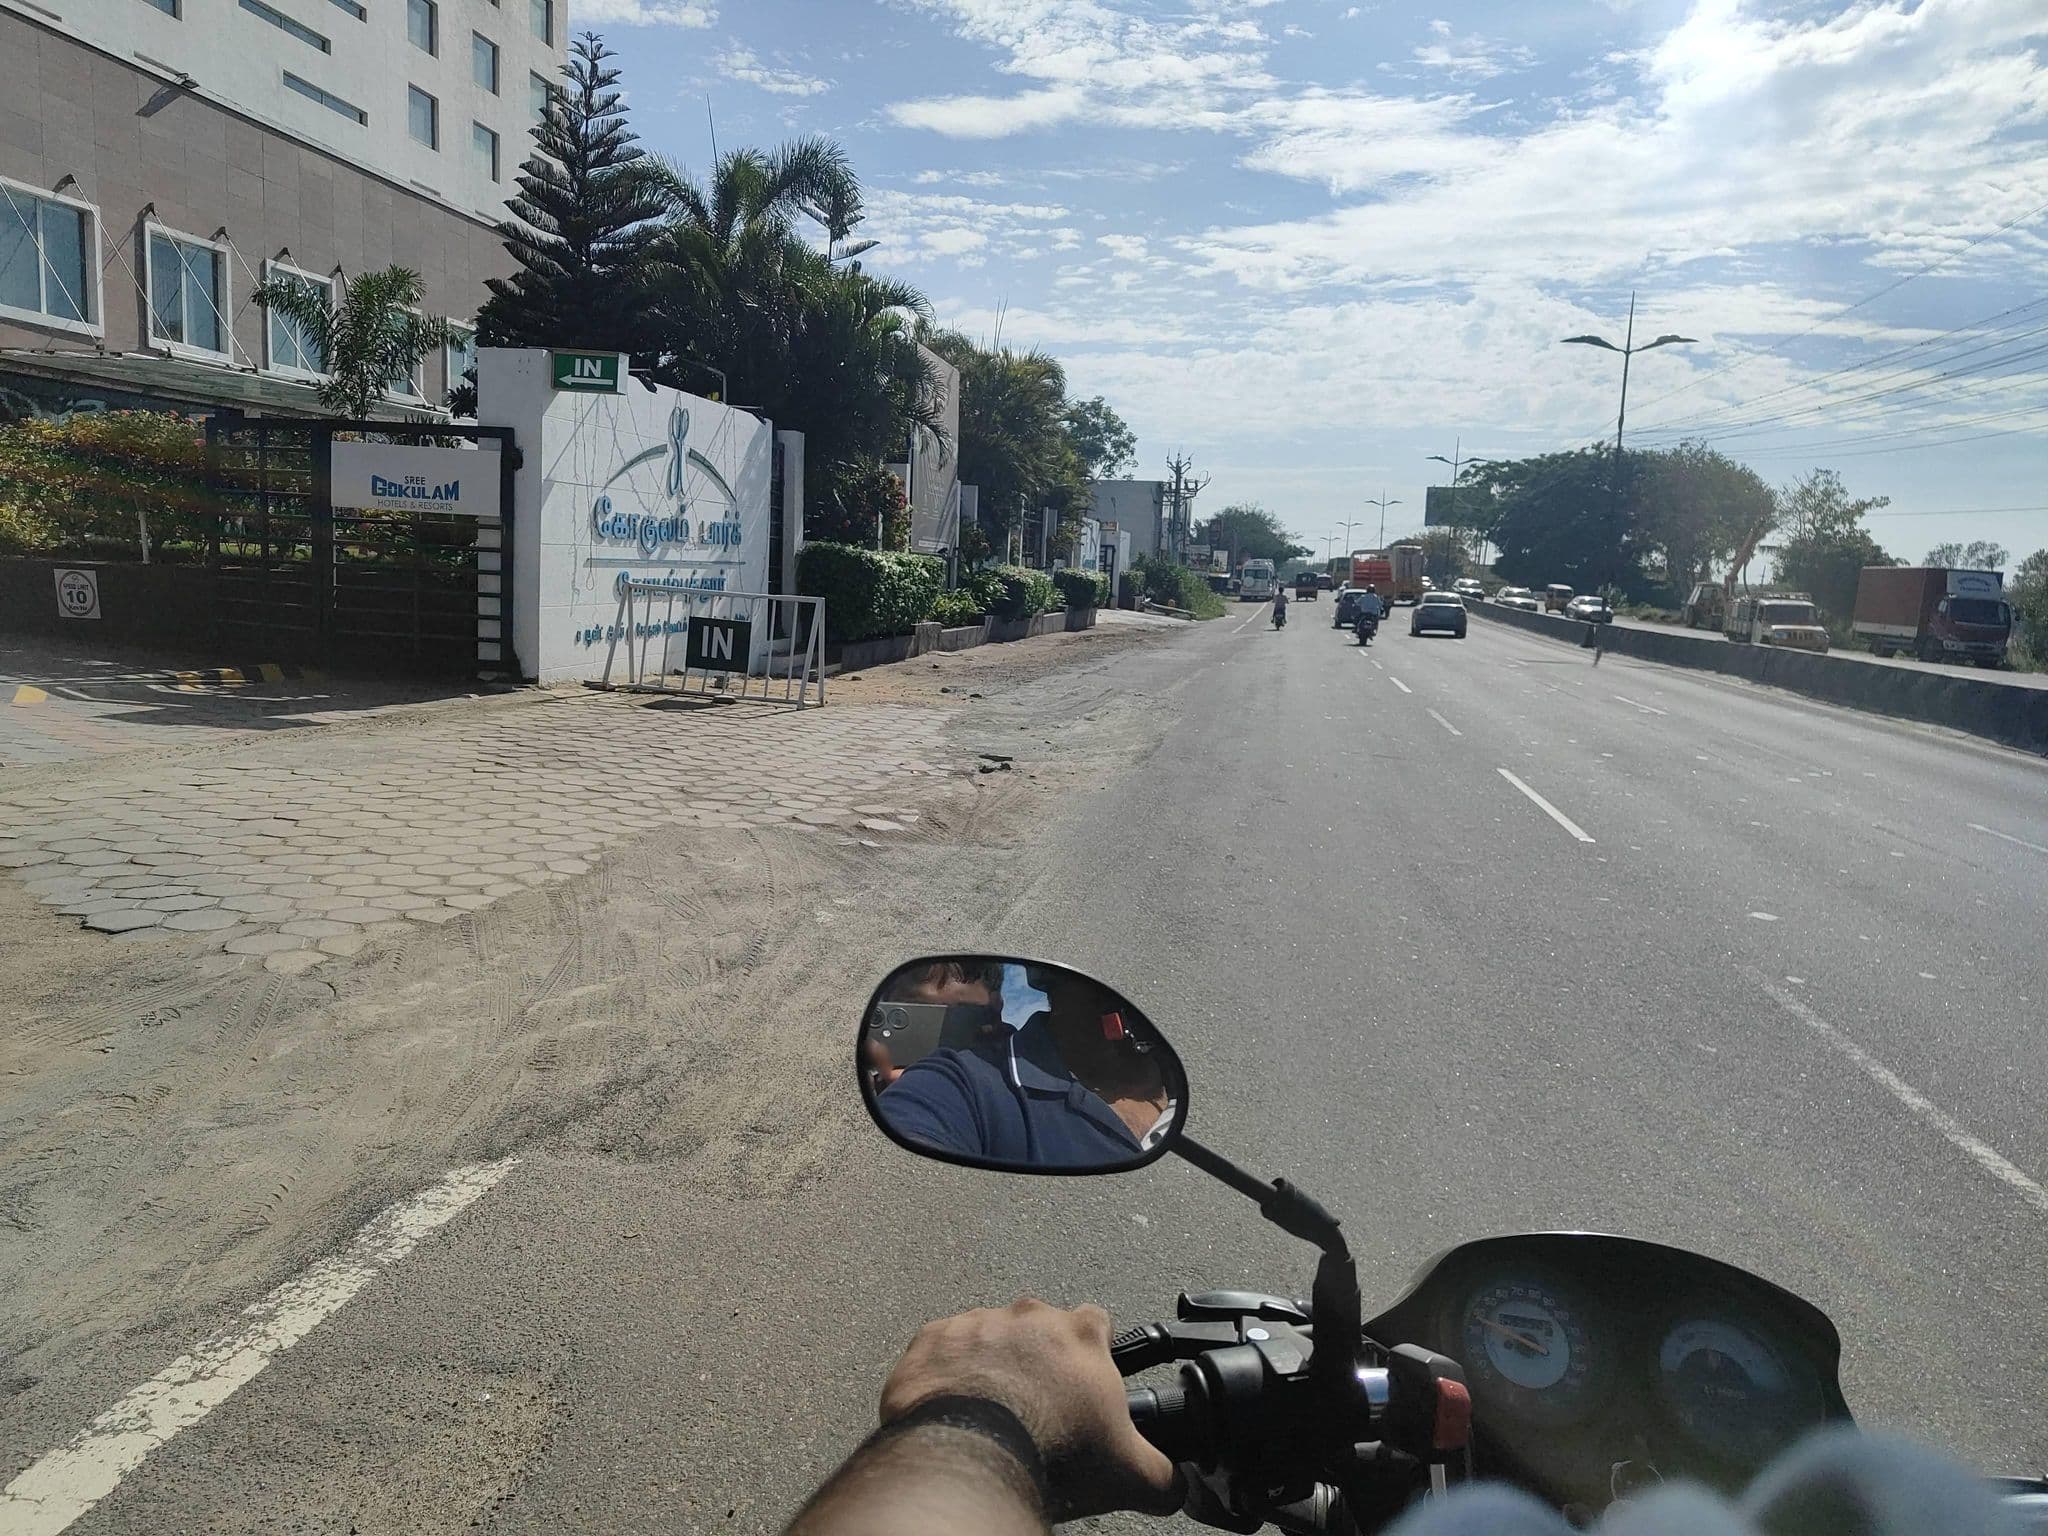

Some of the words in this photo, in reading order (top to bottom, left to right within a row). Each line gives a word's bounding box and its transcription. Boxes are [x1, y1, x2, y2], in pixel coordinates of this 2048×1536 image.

[574, 358, 602, 378] IN
[371, 474, 460, 501] GOKULAM
[404, 475, 426, 485] SREE
[377, 499, 407, 509] HOTELS
[418, 501, 454, 511] RESORTS
[593, 495, 690, 554] கோகுலம்
[66, 590, 88, 604] 10
[701, 625, 734, 661] IN
